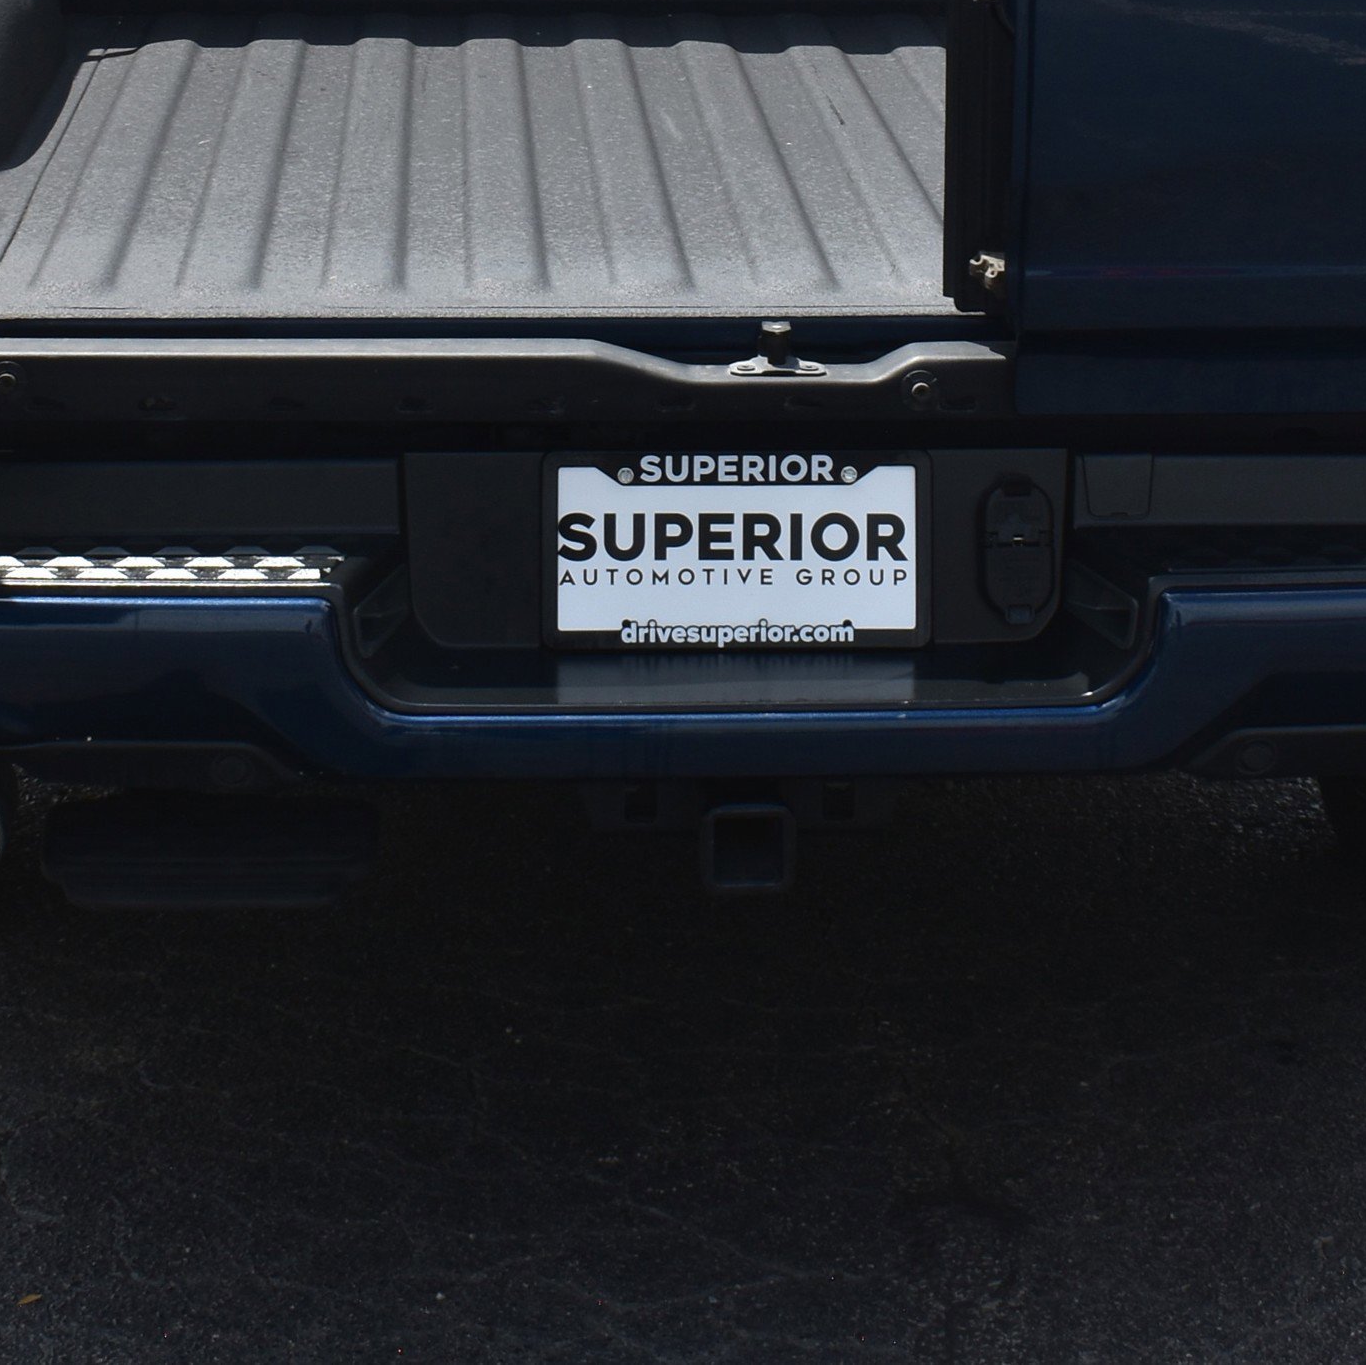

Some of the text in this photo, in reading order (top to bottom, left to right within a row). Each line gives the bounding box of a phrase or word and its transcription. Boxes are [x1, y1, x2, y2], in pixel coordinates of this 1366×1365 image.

[639, 454, 834, 482] SUPERIOR
[558, 512, 908, 562] SUPERIOR
[559, 568, 908, 586] AUTOMOTIVE GROUP
[620, 618, 855, 648] drivesuperior.com
